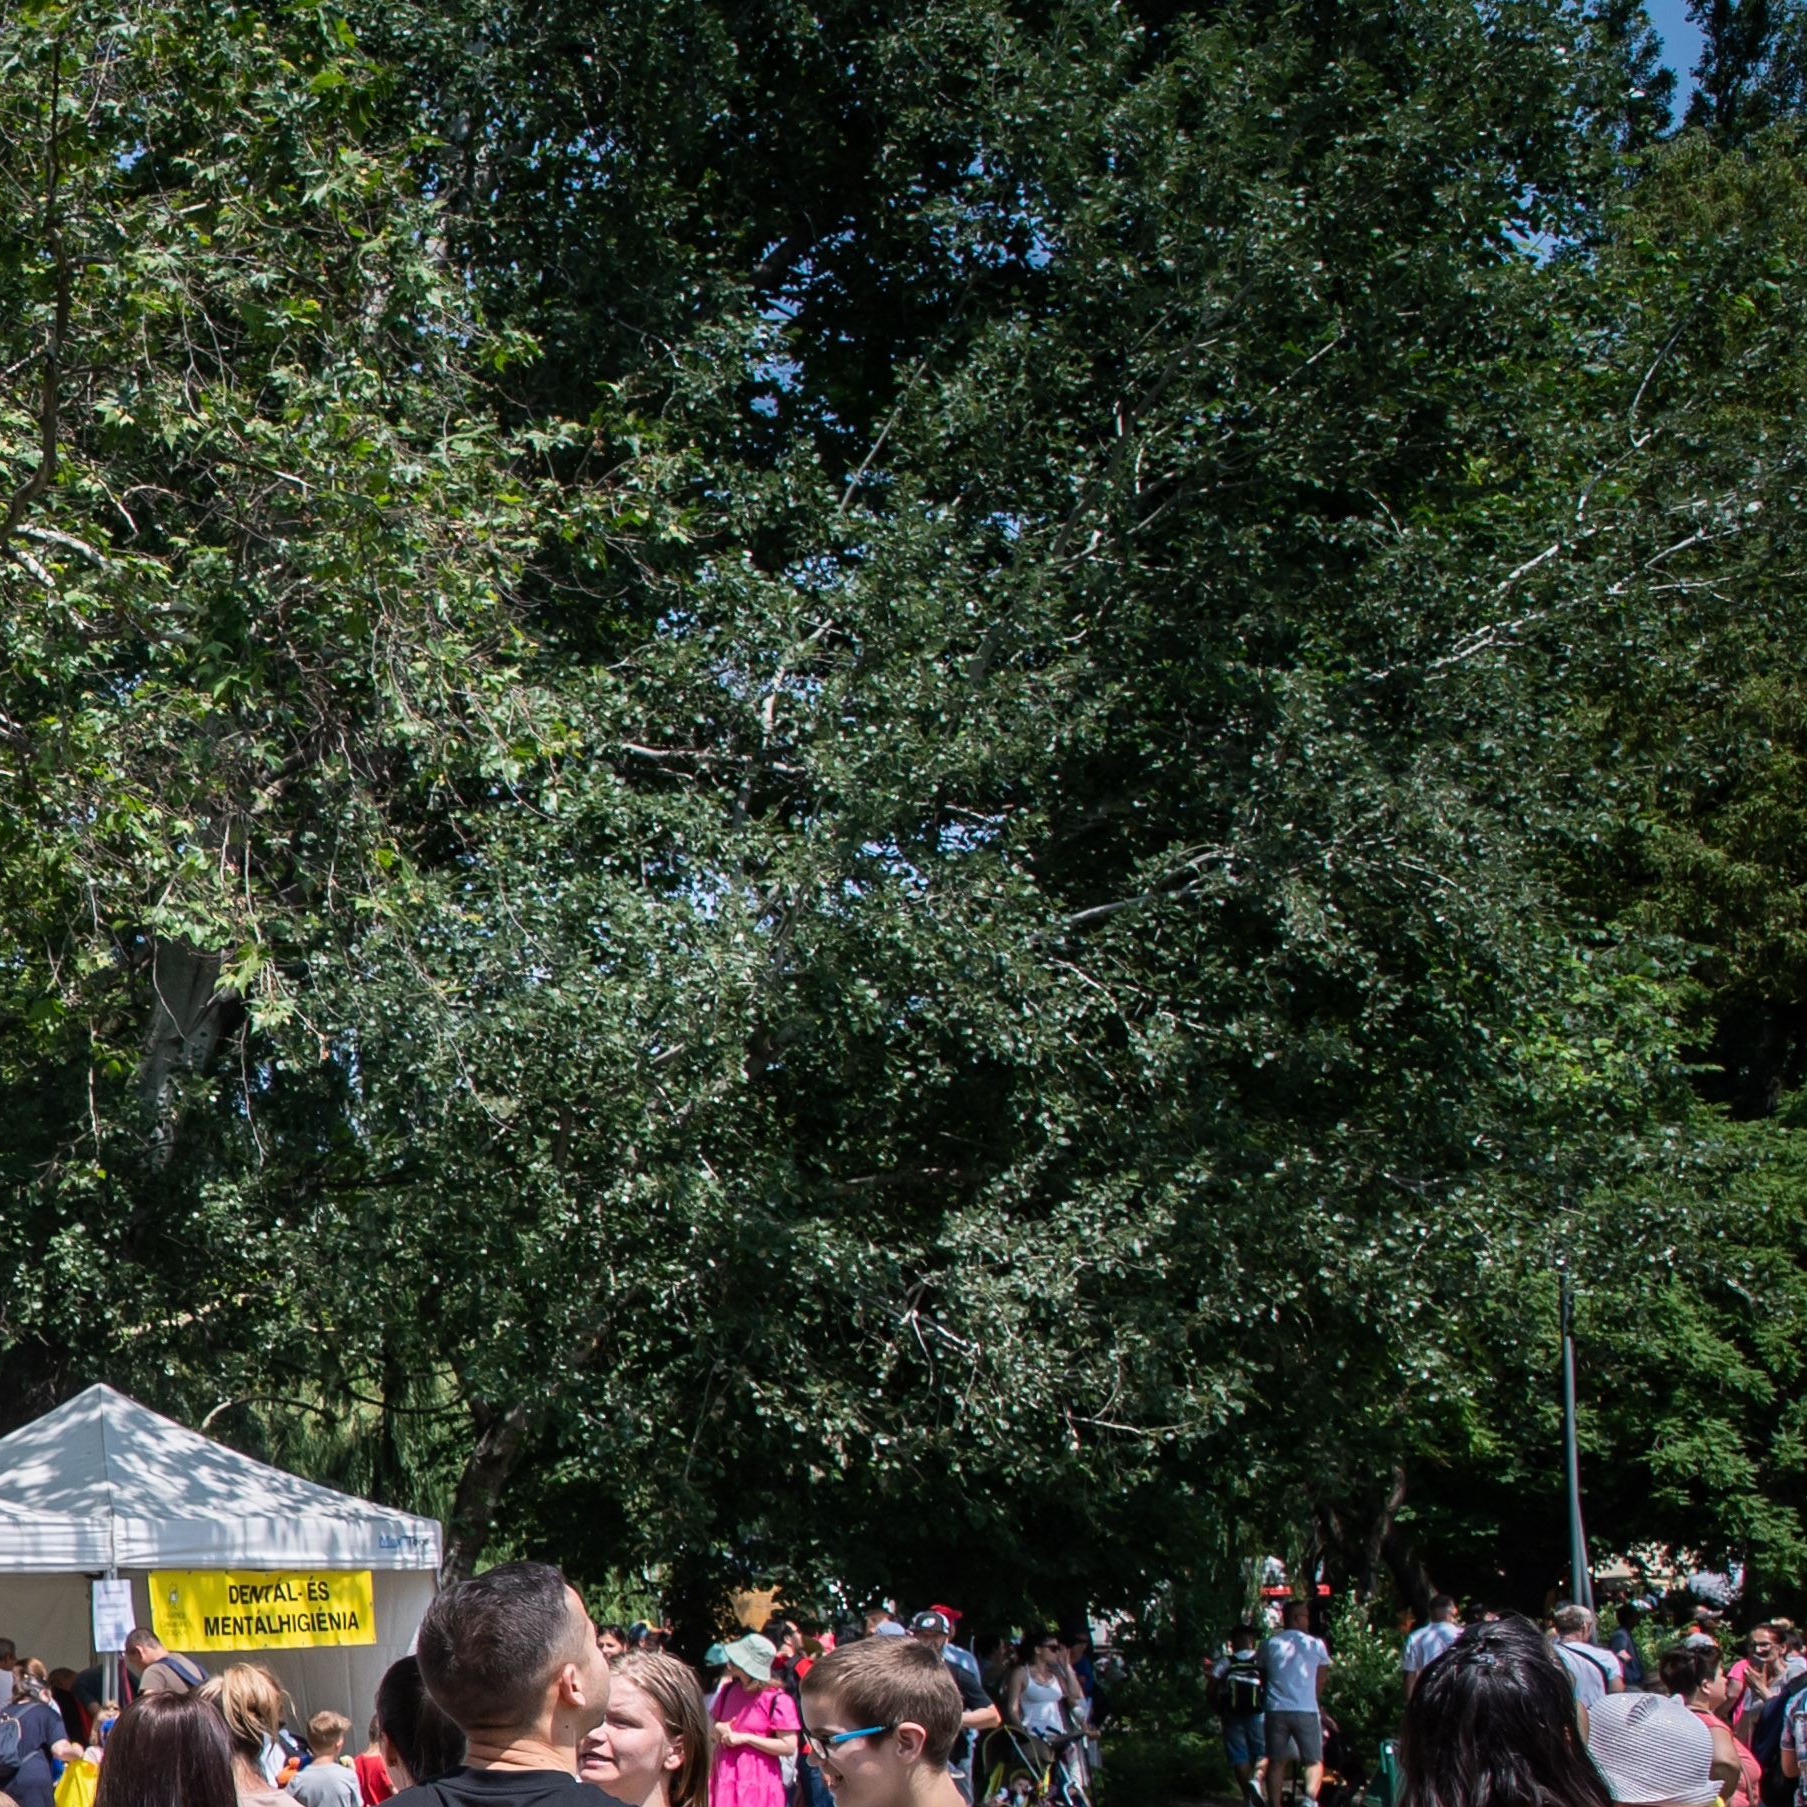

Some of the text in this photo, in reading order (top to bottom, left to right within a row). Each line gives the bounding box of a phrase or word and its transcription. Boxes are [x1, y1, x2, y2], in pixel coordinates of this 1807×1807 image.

[228, 1575, 330, 1605] DENTÁL- ÉS
[204, 1606, 360, 1636] MENTÁLHIGIÉNIA
